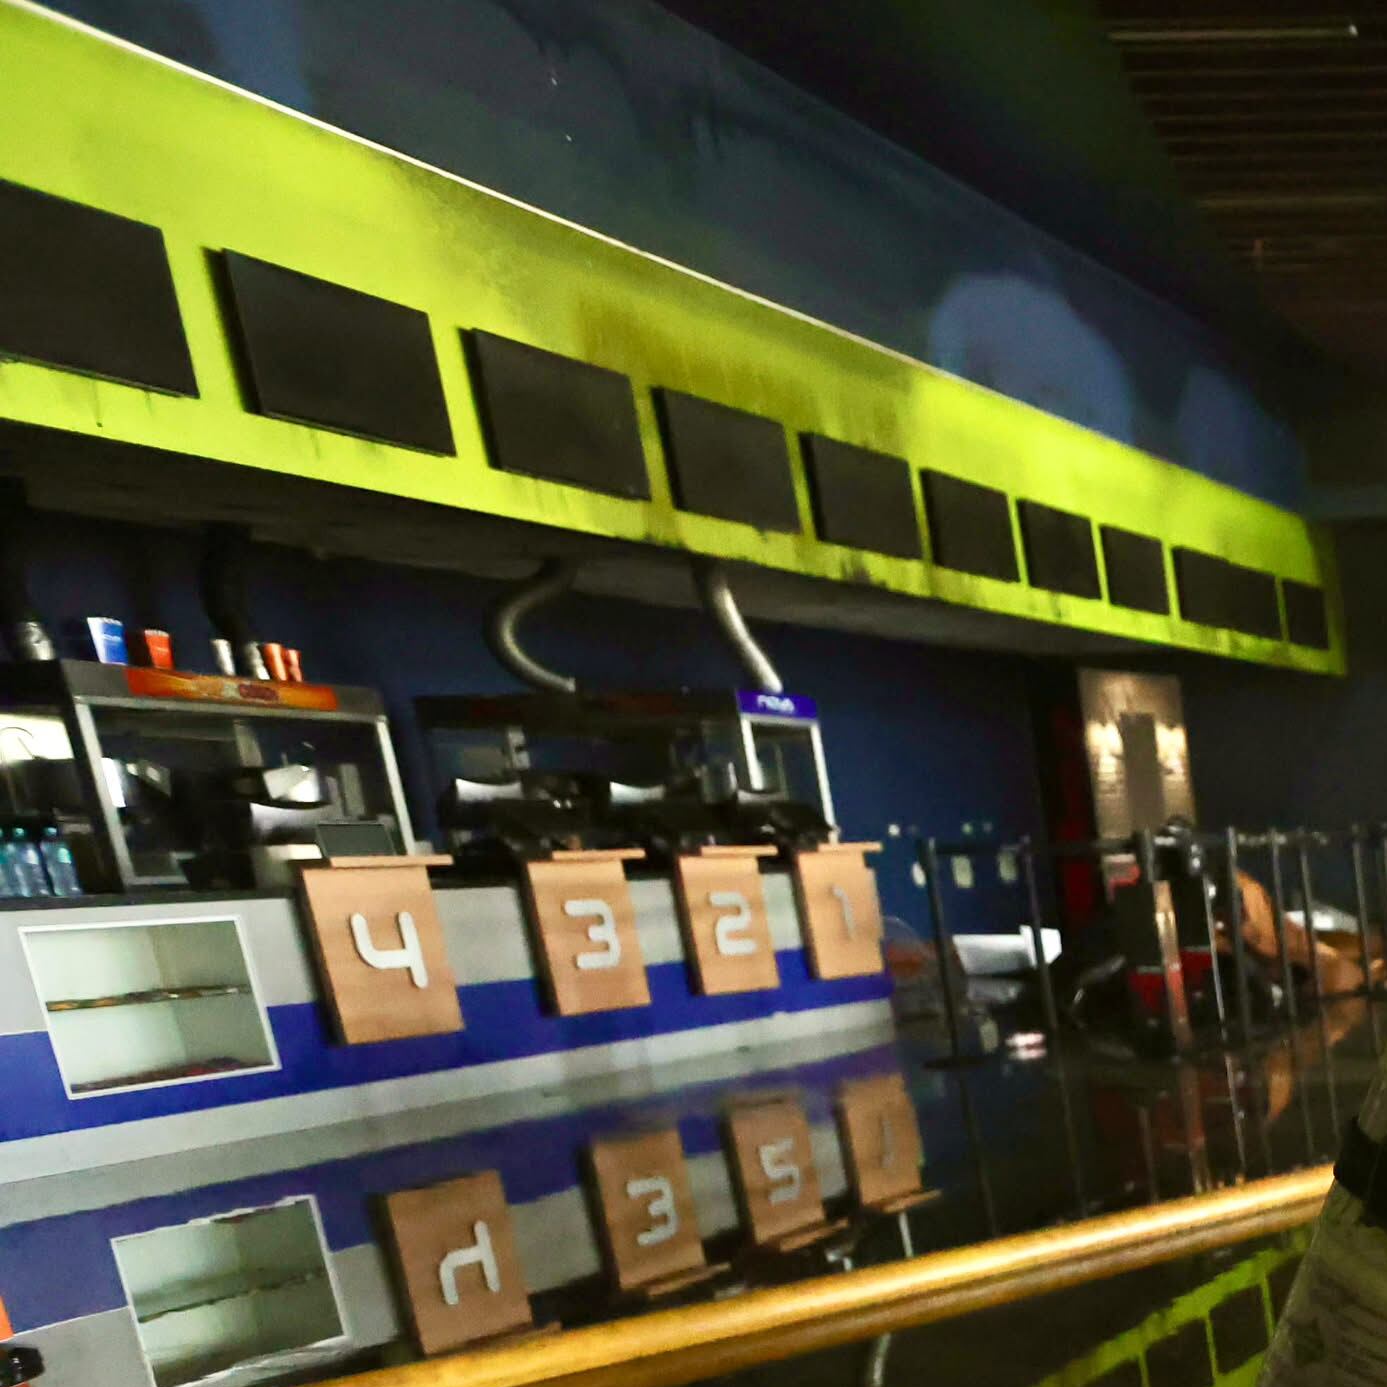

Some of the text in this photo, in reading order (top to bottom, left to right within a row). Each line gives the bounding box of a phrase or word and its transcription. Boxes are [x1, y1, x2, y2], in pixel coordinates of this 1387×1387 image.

[565, 900, 621, 969] 3
[709, 892, 757, 955] 2
[833, 887, 857, 939] 1
[351, 912, 427, 988] 4
